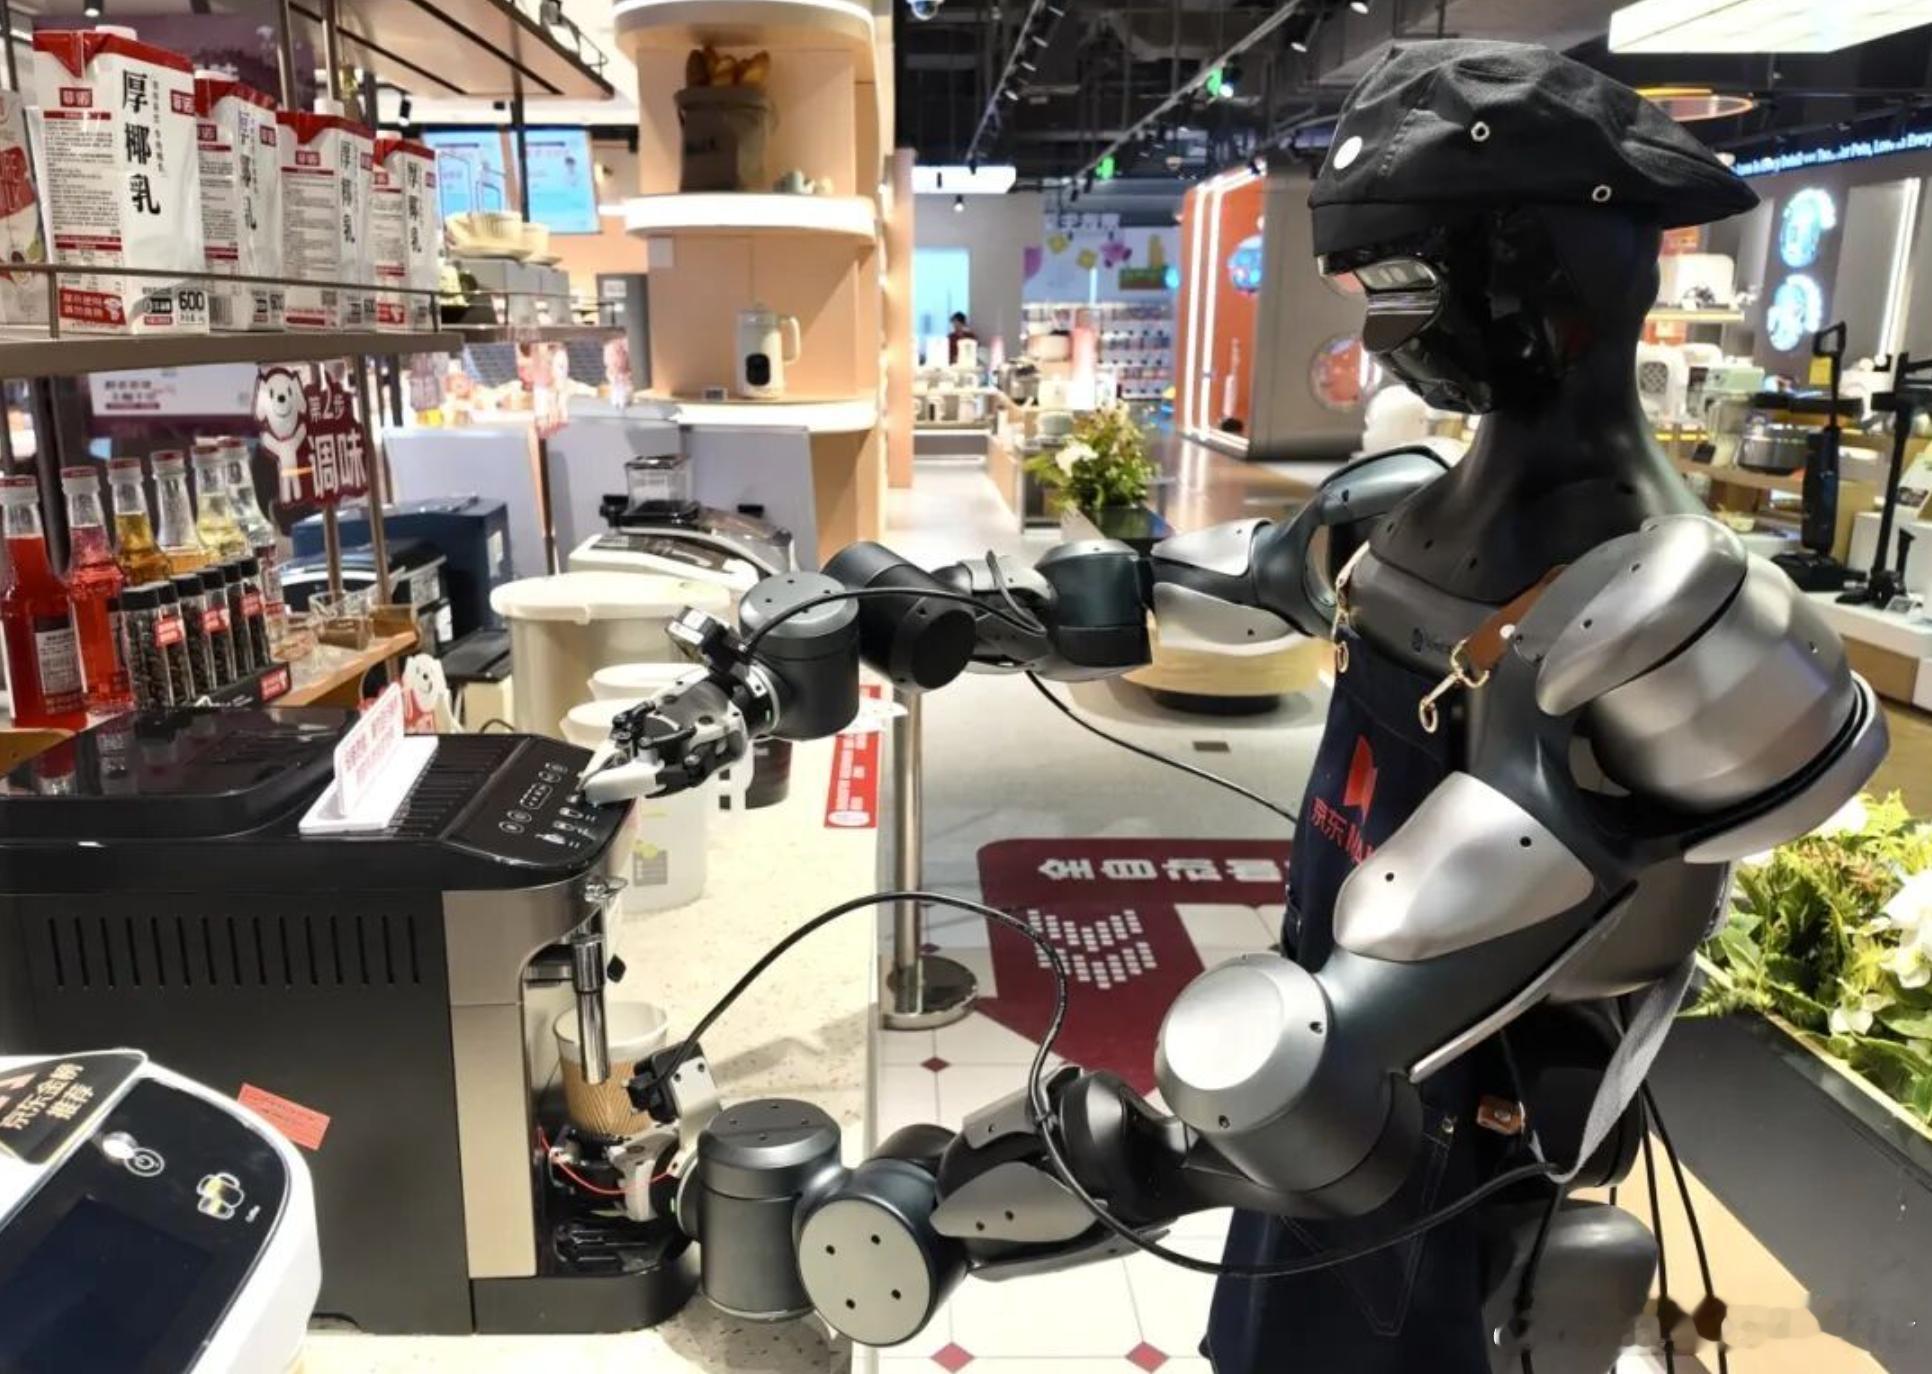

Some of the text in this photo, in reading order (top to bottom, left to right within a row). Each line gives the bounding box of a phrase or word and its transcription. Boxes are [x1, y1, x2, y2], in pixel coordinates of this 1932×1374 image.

[122, 69, 161, 215] 厚椰乳
[178, 291, 204, 311] 600
[308, 385, 346, 424] 第2步
[307, 427, 368, 499] 调味
